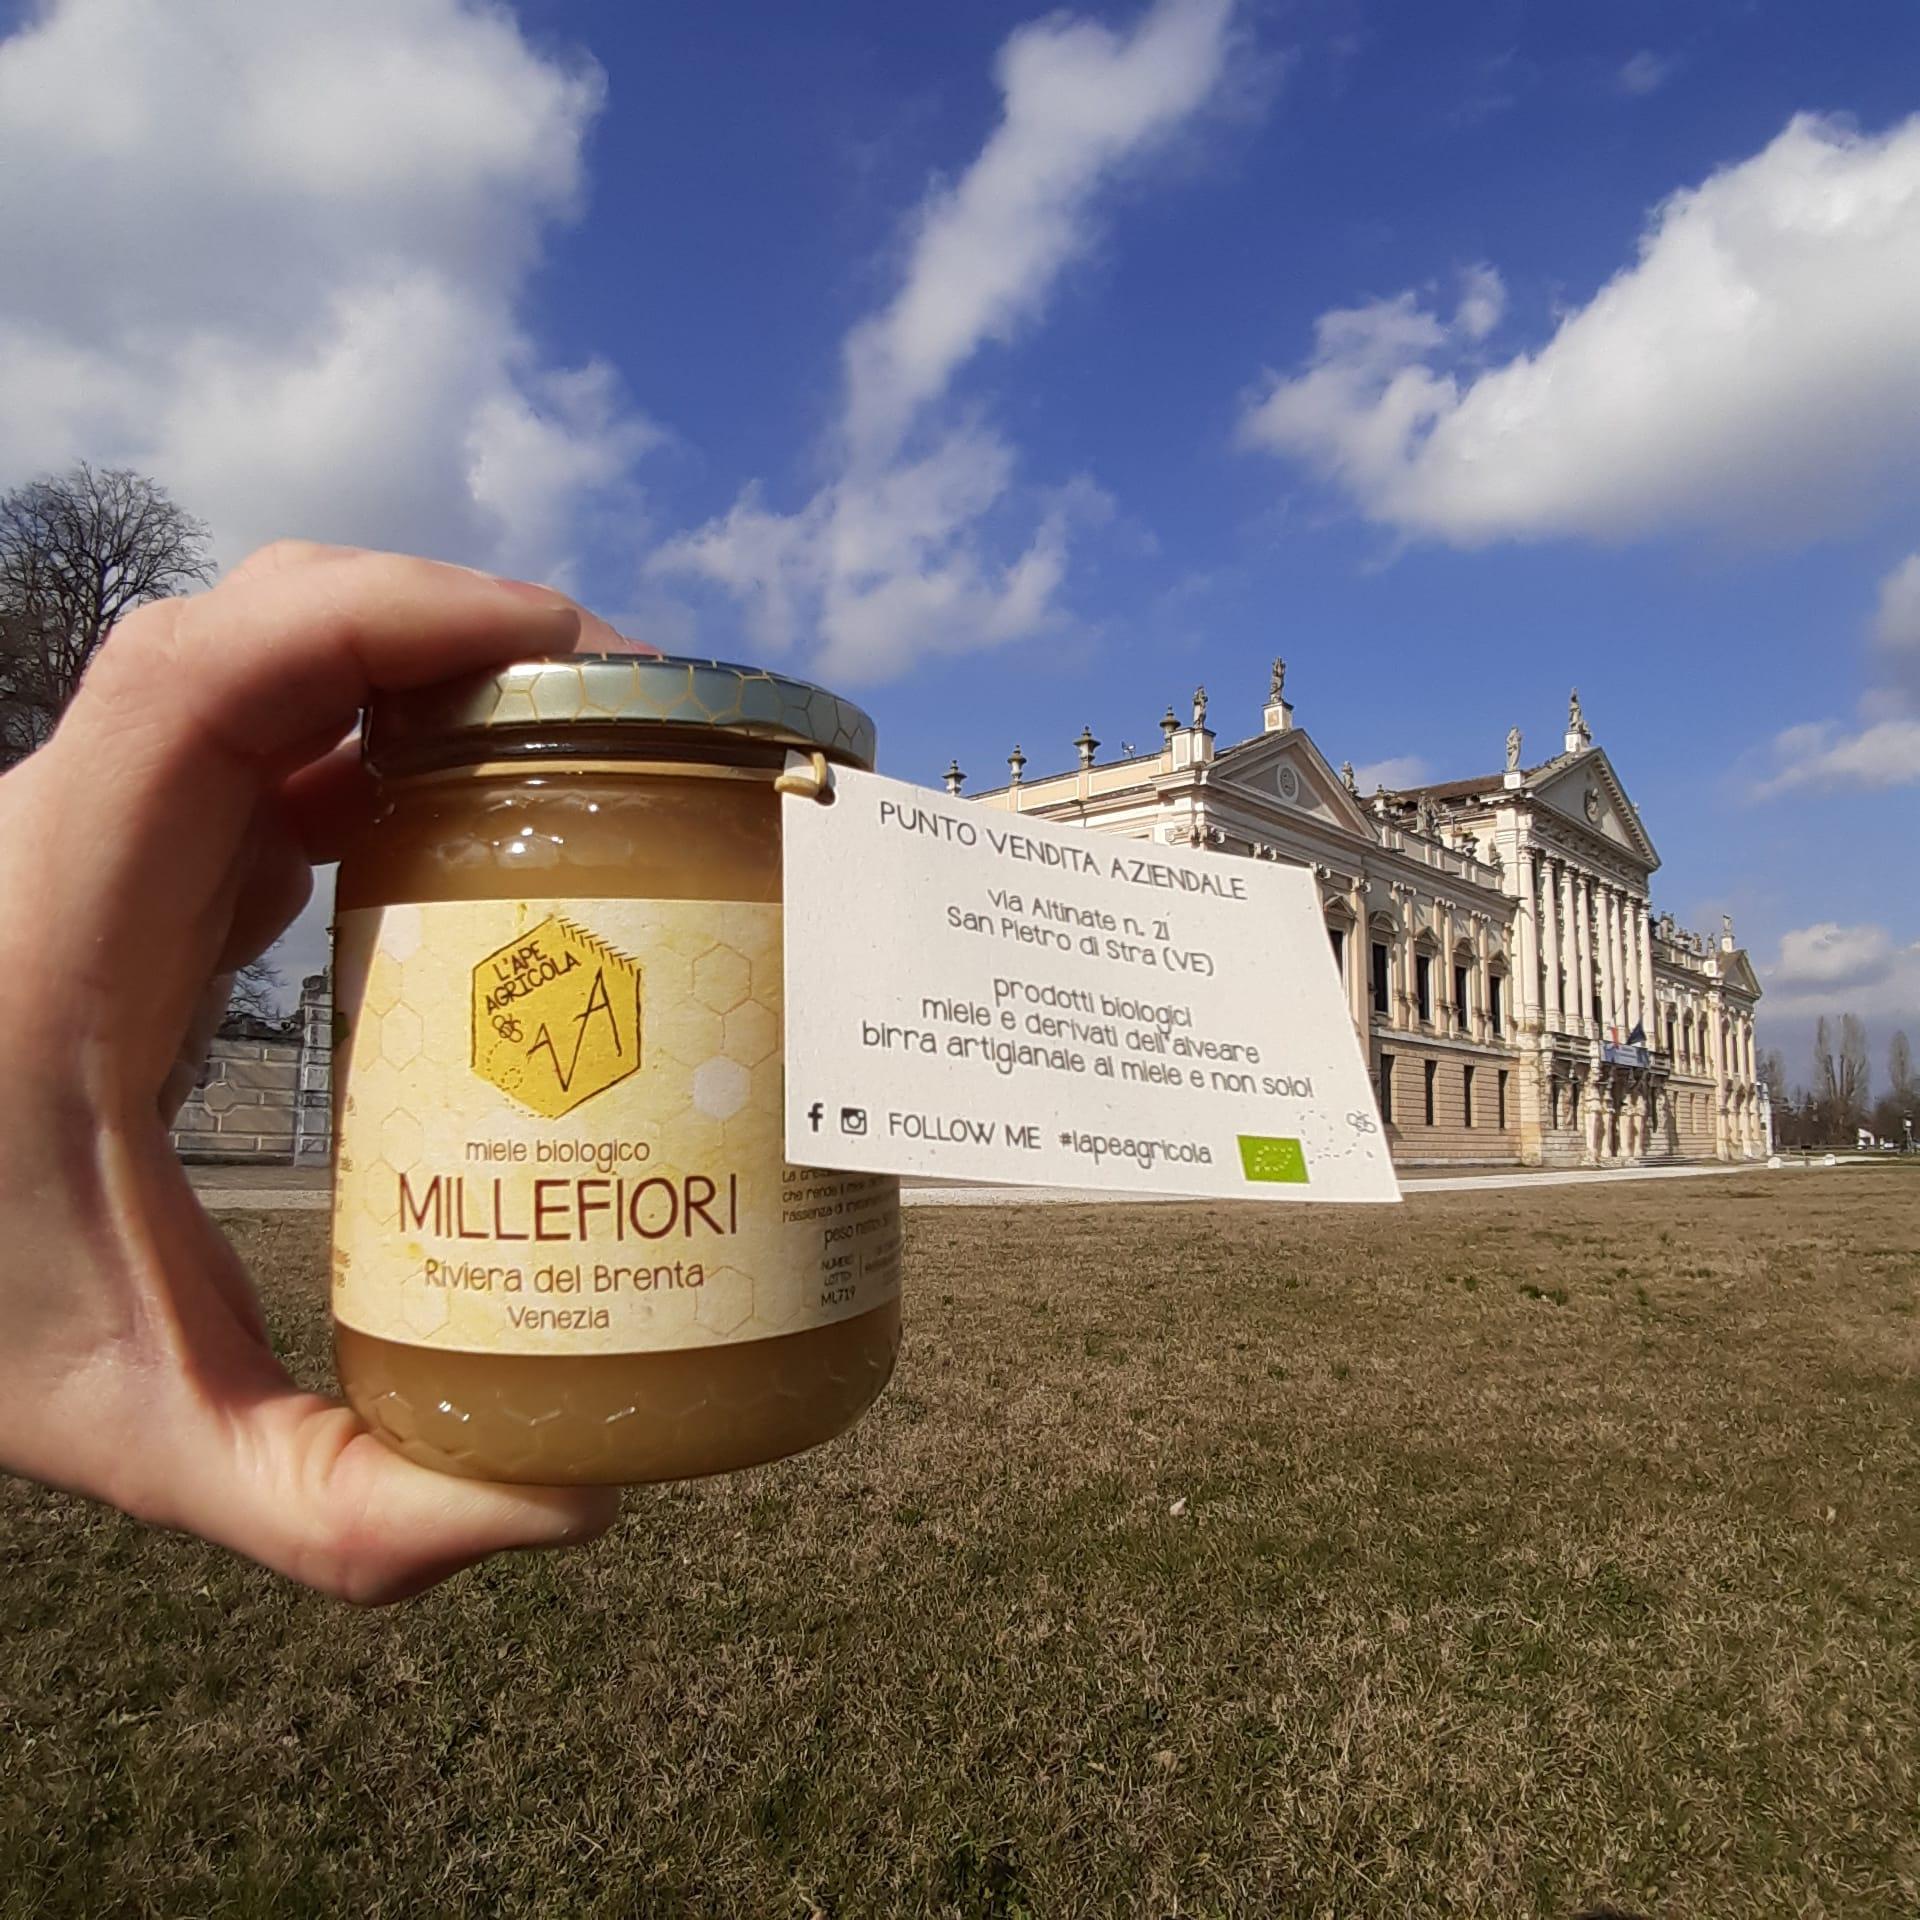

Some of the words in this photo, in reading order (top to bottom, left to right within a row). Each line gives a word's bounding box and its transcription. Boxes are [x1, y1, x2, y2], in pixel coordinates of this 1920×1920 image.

[880, 801, 977, 846] PUNTO
[986, 828, 1101, 876] VENDITA
[1111, 858, 1248, 900] AZIENDALE
[947, 906, 994, 935] San
[1002, 919, 1071, 951] Pietro
[1079, 935, 1099, 957] di
[1107, 940, 1156, 967] Stra
[1164, 946, 1214, 977] (VE)
[1033, 897, 1116, 931] Altinate
[1124, 919, 1145, 937] n.
[485, 950, 582, 1016] AGRICOLA
[493, 940, 548, 981] L'APE
[922, 998, 991, 1026] miele
[1001, 1010, 1016, 1030] e
[1025, 1013, 1118, 1048] derivati
[1126, 1030, 1260, 1064] dell'alveare
[994, 978, 1094, 1013] prodotti
[1101, 995, 1192, 1034] biologici
[862, 1020, 937, 1053] birra
[947, 1035, 1085, 1075] artigianale
[1094, 1056, 1114, 1077] al
[1121, 1060, 1182, 1086] miele
[1190, 1070, 1205, 1088] e
[1211, 1071, 1256, 1094] non
[1263, 1076, 1314, 1099] solo!
[465, 1139, 528, 1162] miele
[536, 1138, 651, 1174] biologico
[889, 1113, 996, 1146] FOLLOW
[1005, 1125, 1042, 1150] ME
[1058, 1131, 1213, 1169] #lapeagricola
[399, 1172, 737, 1242] MILLEFIORI
[824, 1225, 854, 1250] peso
[424, 1258, 522, 1293] Riviera
[534, 1264, 581, 1294] del
[594, 1260, 704, 1293] Brenta
[507, 1305, 610, 1330] Venezia
